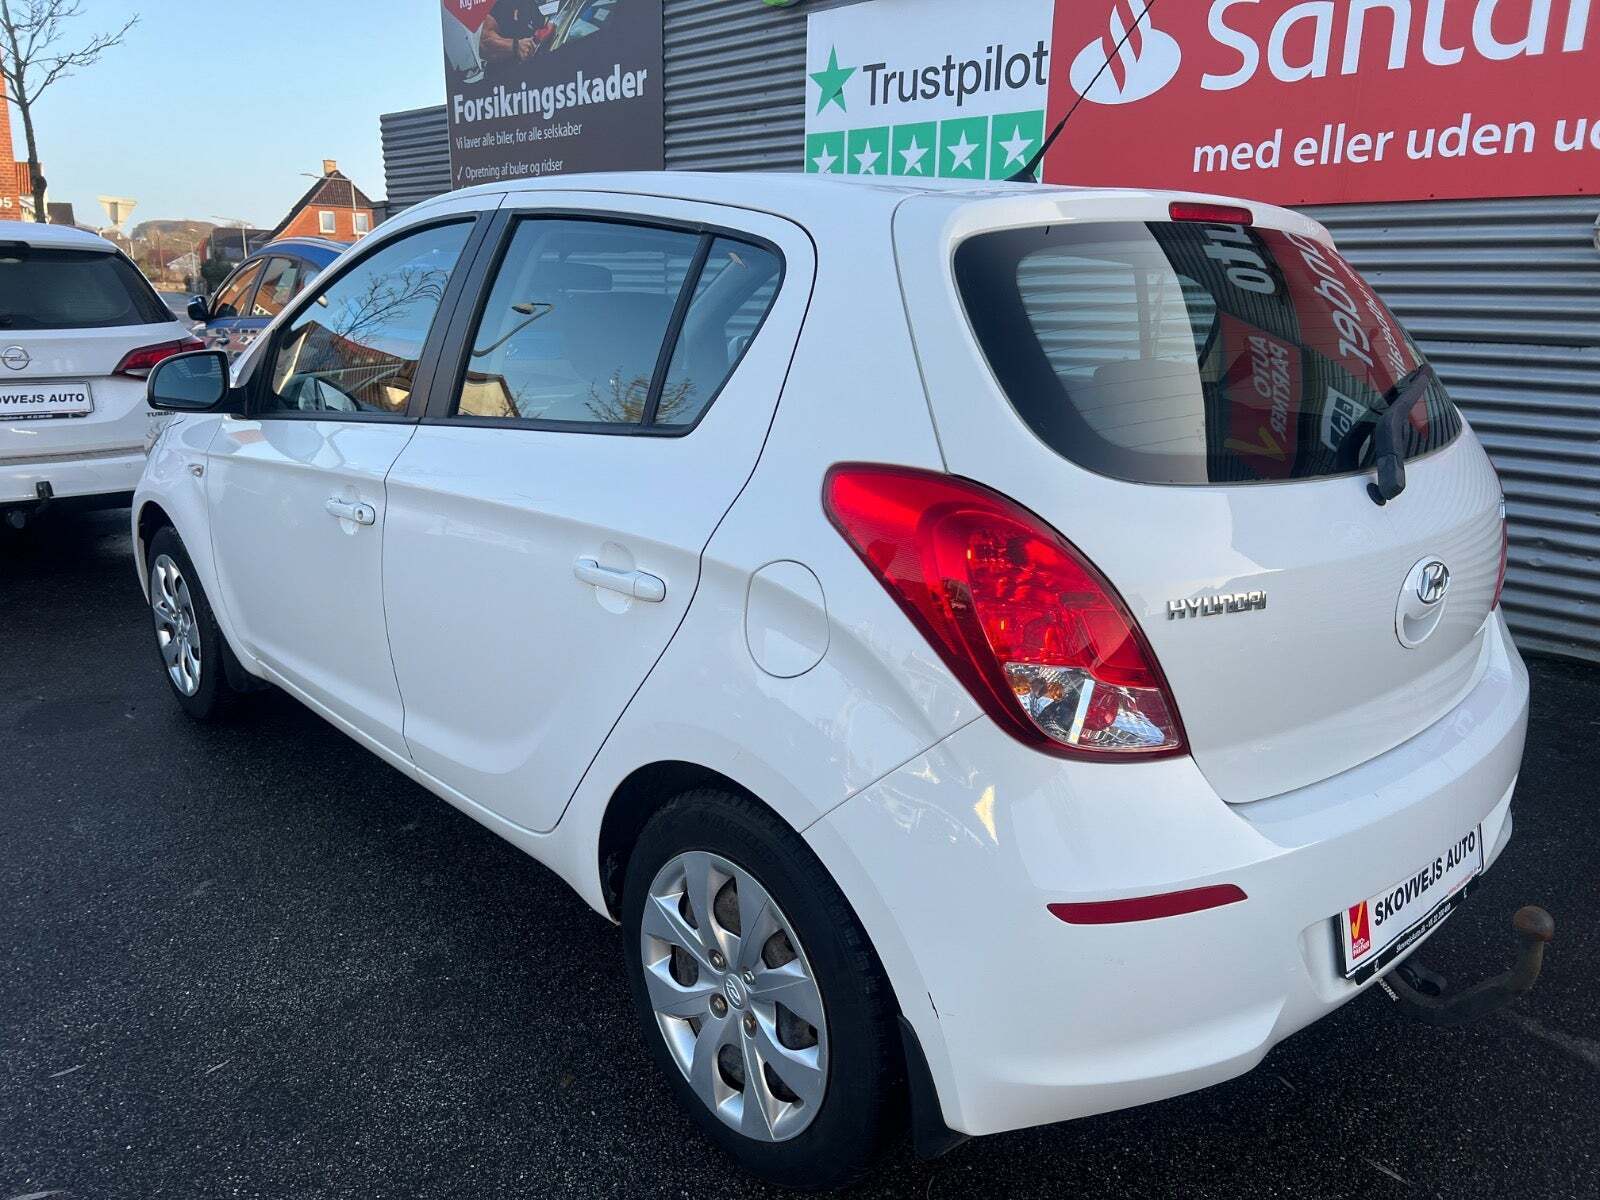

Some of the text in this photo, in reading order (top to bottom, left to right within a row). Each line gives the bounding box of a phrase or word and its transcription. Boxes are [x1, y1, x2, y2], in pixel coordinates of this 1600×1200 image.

[454, 64, 648, 124] Forsikringsskader
[863, 40, 1048, 107] Trustpilot
[455, 121, 582, 149] Vi laver alle biler, for alle selskaber
[1193, 129, 1282, 173] med
[1294, 122, 1394, 167] eller
[1407, 112, 1536, 160] uden
[465, 157, 563, 181] Opretning af buler og ridser
[0, 392, 85, 404] VVEJS AUTO
[1167, 590, 1267, 621] HYUNDAI
[1374, 856, 1443, 927] SKOVVEJS
[1446, 831, 1476, 873] AUTO
